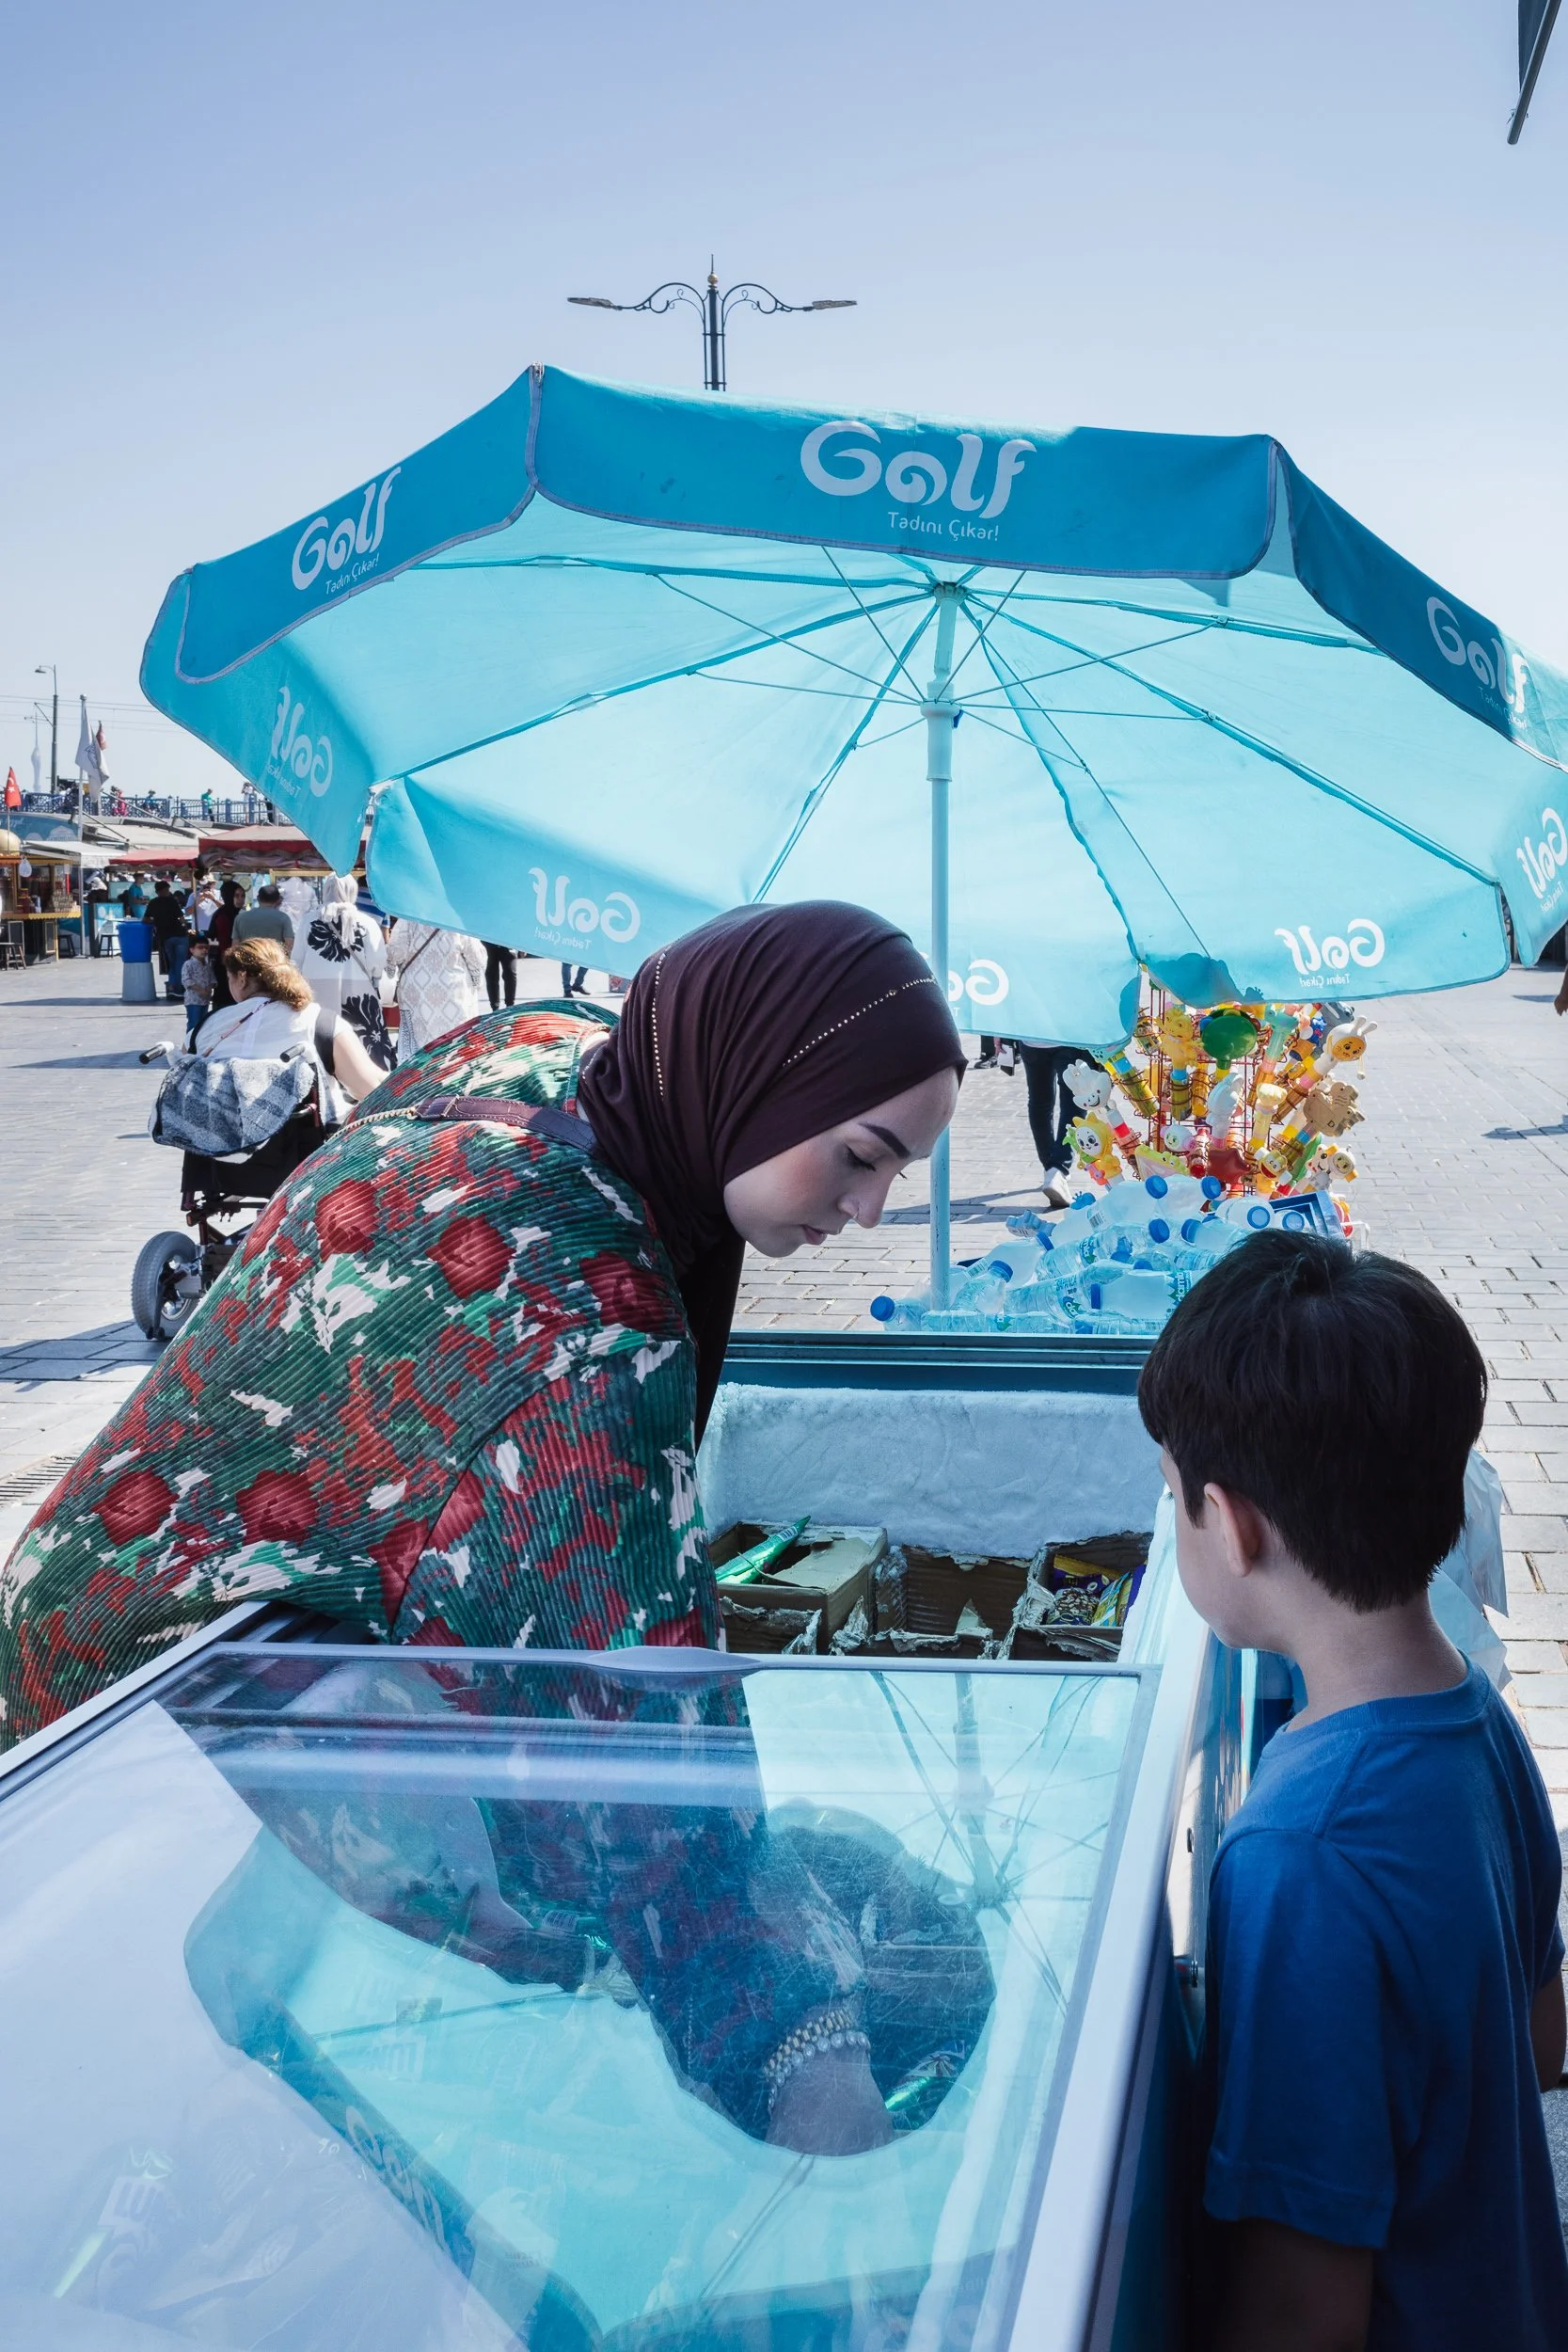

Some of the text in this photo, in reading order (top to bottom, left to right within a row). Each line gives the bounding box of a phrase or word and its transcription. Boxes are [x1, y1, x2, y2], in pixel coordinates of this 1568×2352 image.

[800, 420, 1037, 518] Golf
[292, 466, 402, 591] Golf
[888, 512, 999, 542] Tadını Çıkar!
[1426, 596, 1529, 713] Golf
